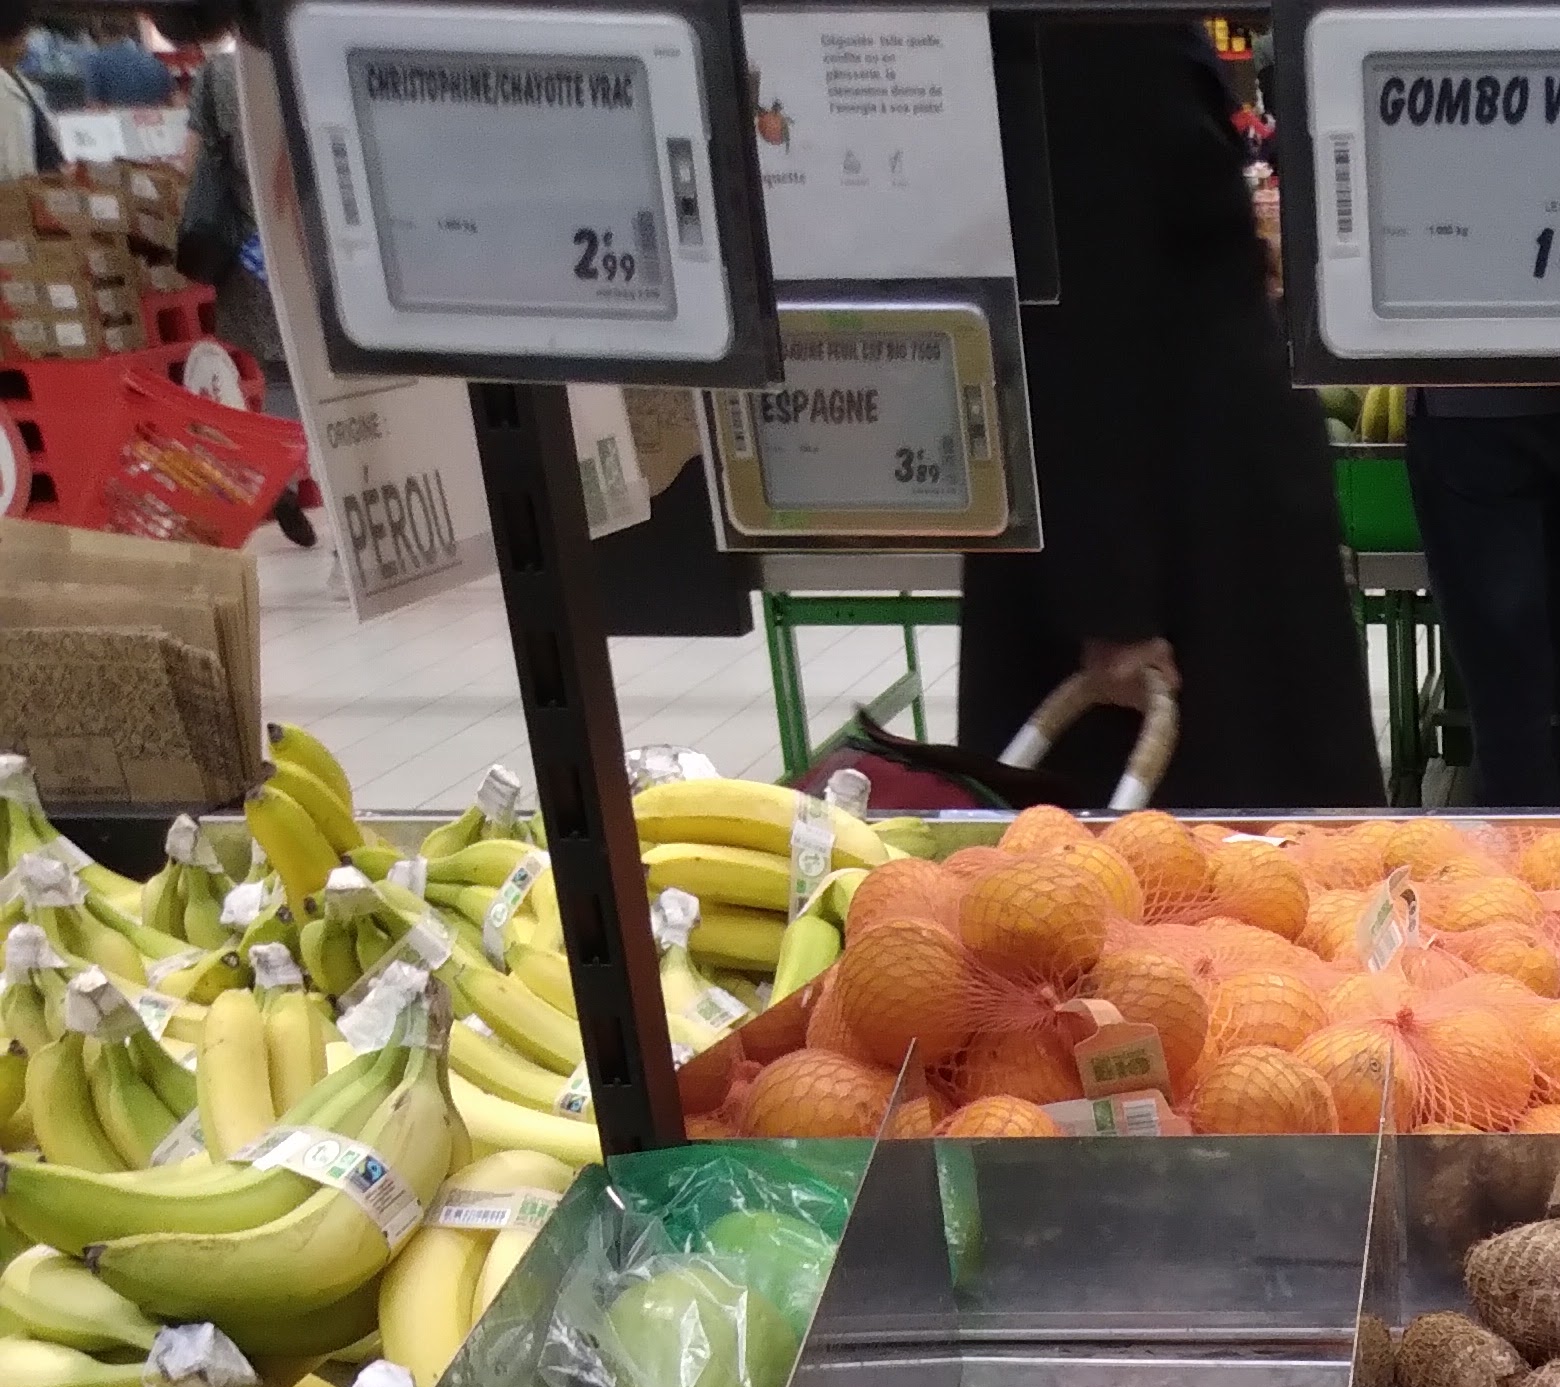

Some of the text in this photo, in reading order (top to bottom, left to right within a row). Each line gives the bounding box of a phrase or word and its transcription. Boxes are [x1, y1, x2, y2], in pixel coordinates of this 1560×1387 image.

[590, 73, 634, 111] VRAC
[1379, 76, 1529, 127] GOMBO
[760, 388, 879, 424] ESPAGNE
[342, 465, 458, 588] PÉROU
